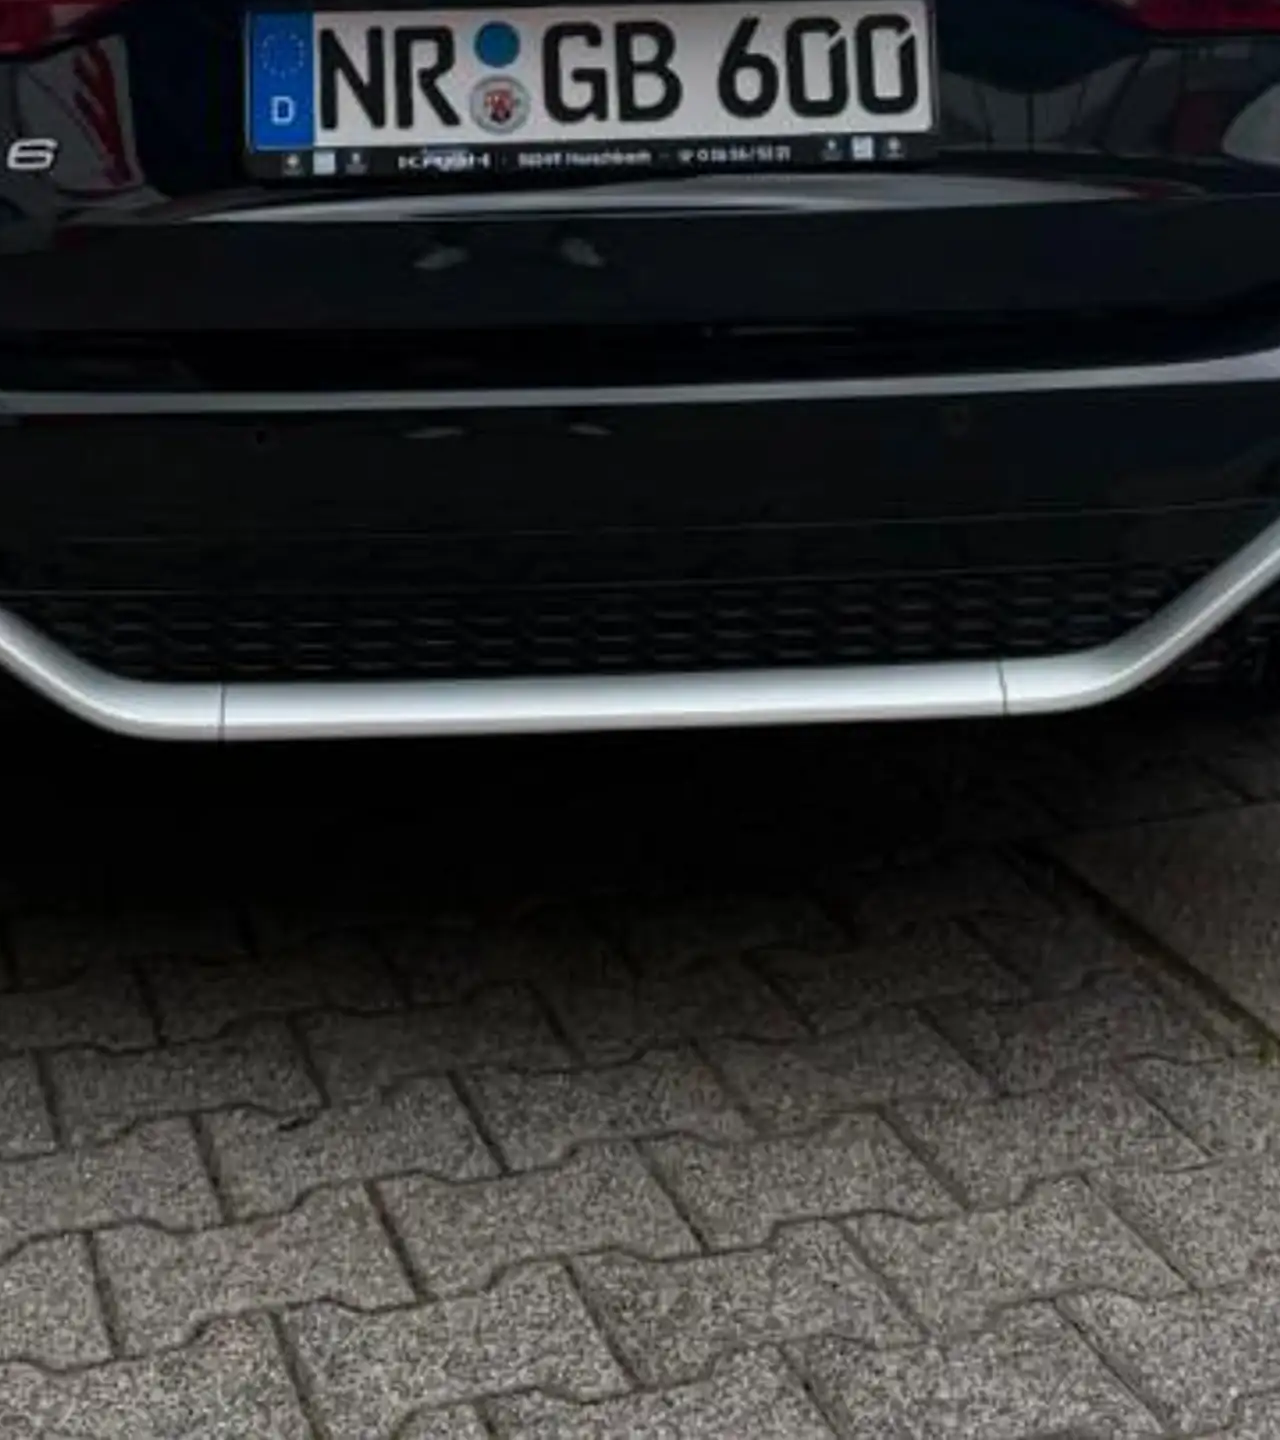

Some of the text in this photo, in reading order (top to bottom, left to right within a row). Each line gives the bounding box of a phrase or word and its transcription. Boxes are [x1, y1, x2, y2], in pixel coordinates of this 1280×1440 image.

[270, 13, 919, 130] D NR GB 600
[6, 136, 59, 172] 6
